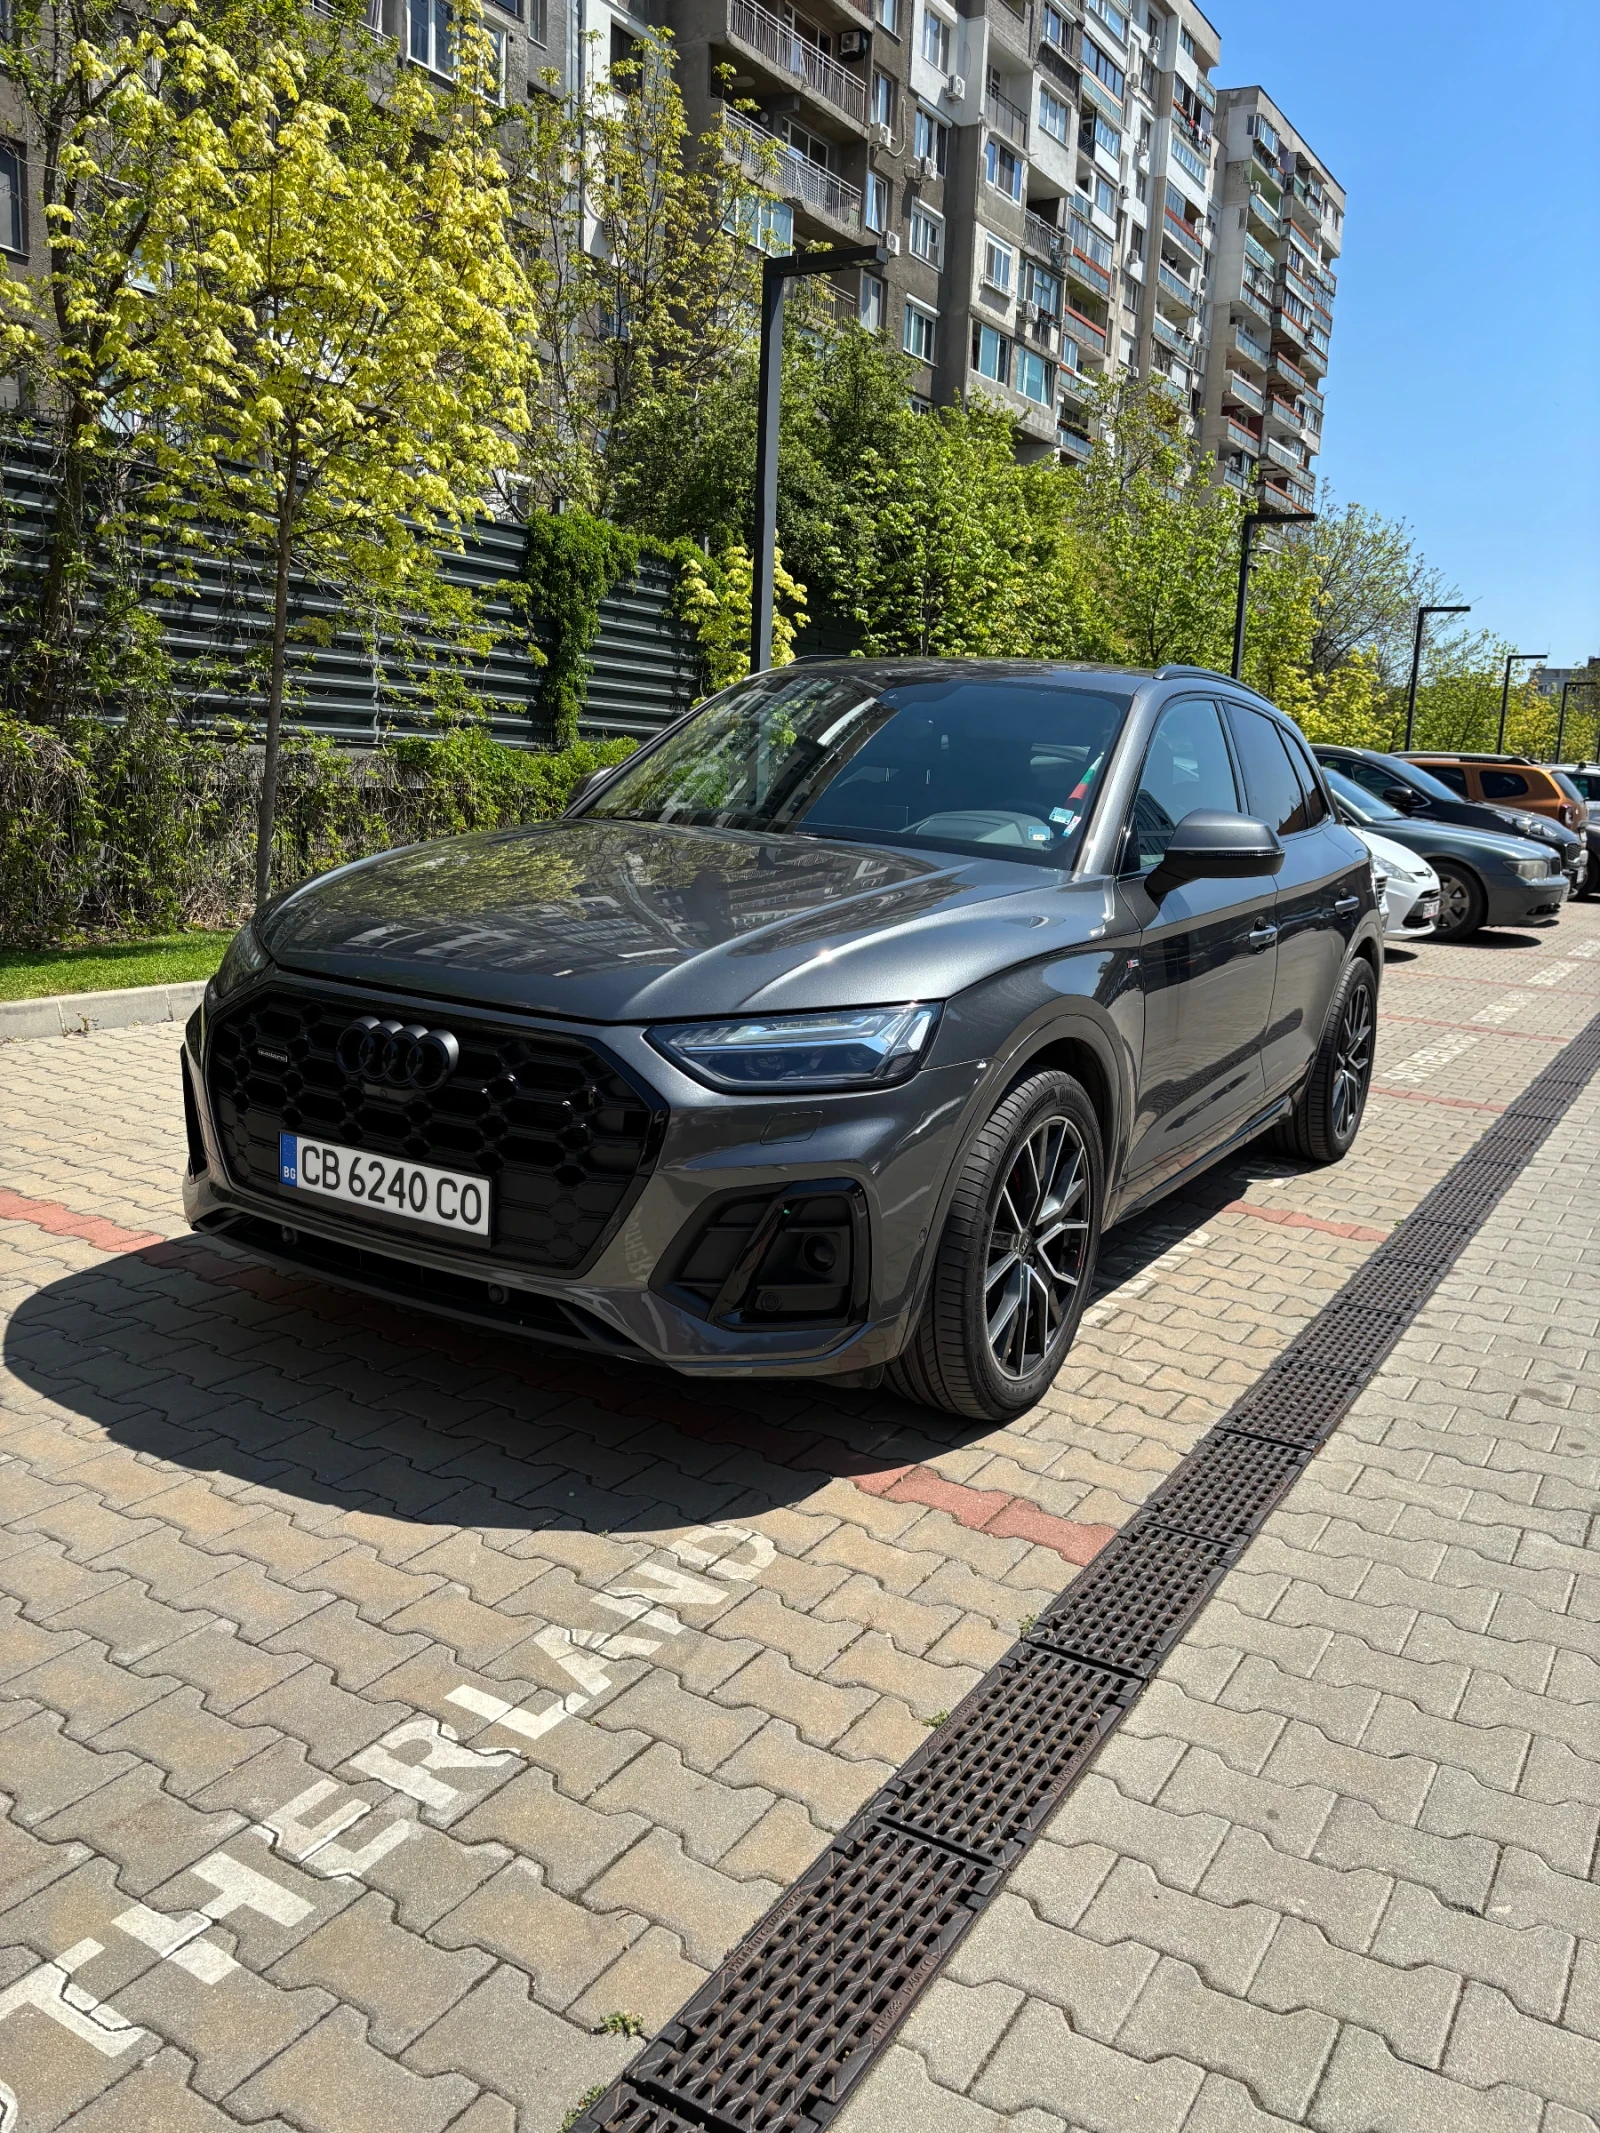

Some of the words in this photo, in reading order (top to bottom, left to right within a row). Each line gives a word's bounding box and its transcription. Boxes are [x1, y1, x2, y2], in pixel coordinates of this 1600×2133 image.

[283, 1165, 296, 1180] BG
[301, 1145, 341, 1191] CB
[348, 1156, 428, 1213] 6240
[435, 1177, 482, 1226] CO
[0, 1524, 777, 2133] THERLAND
